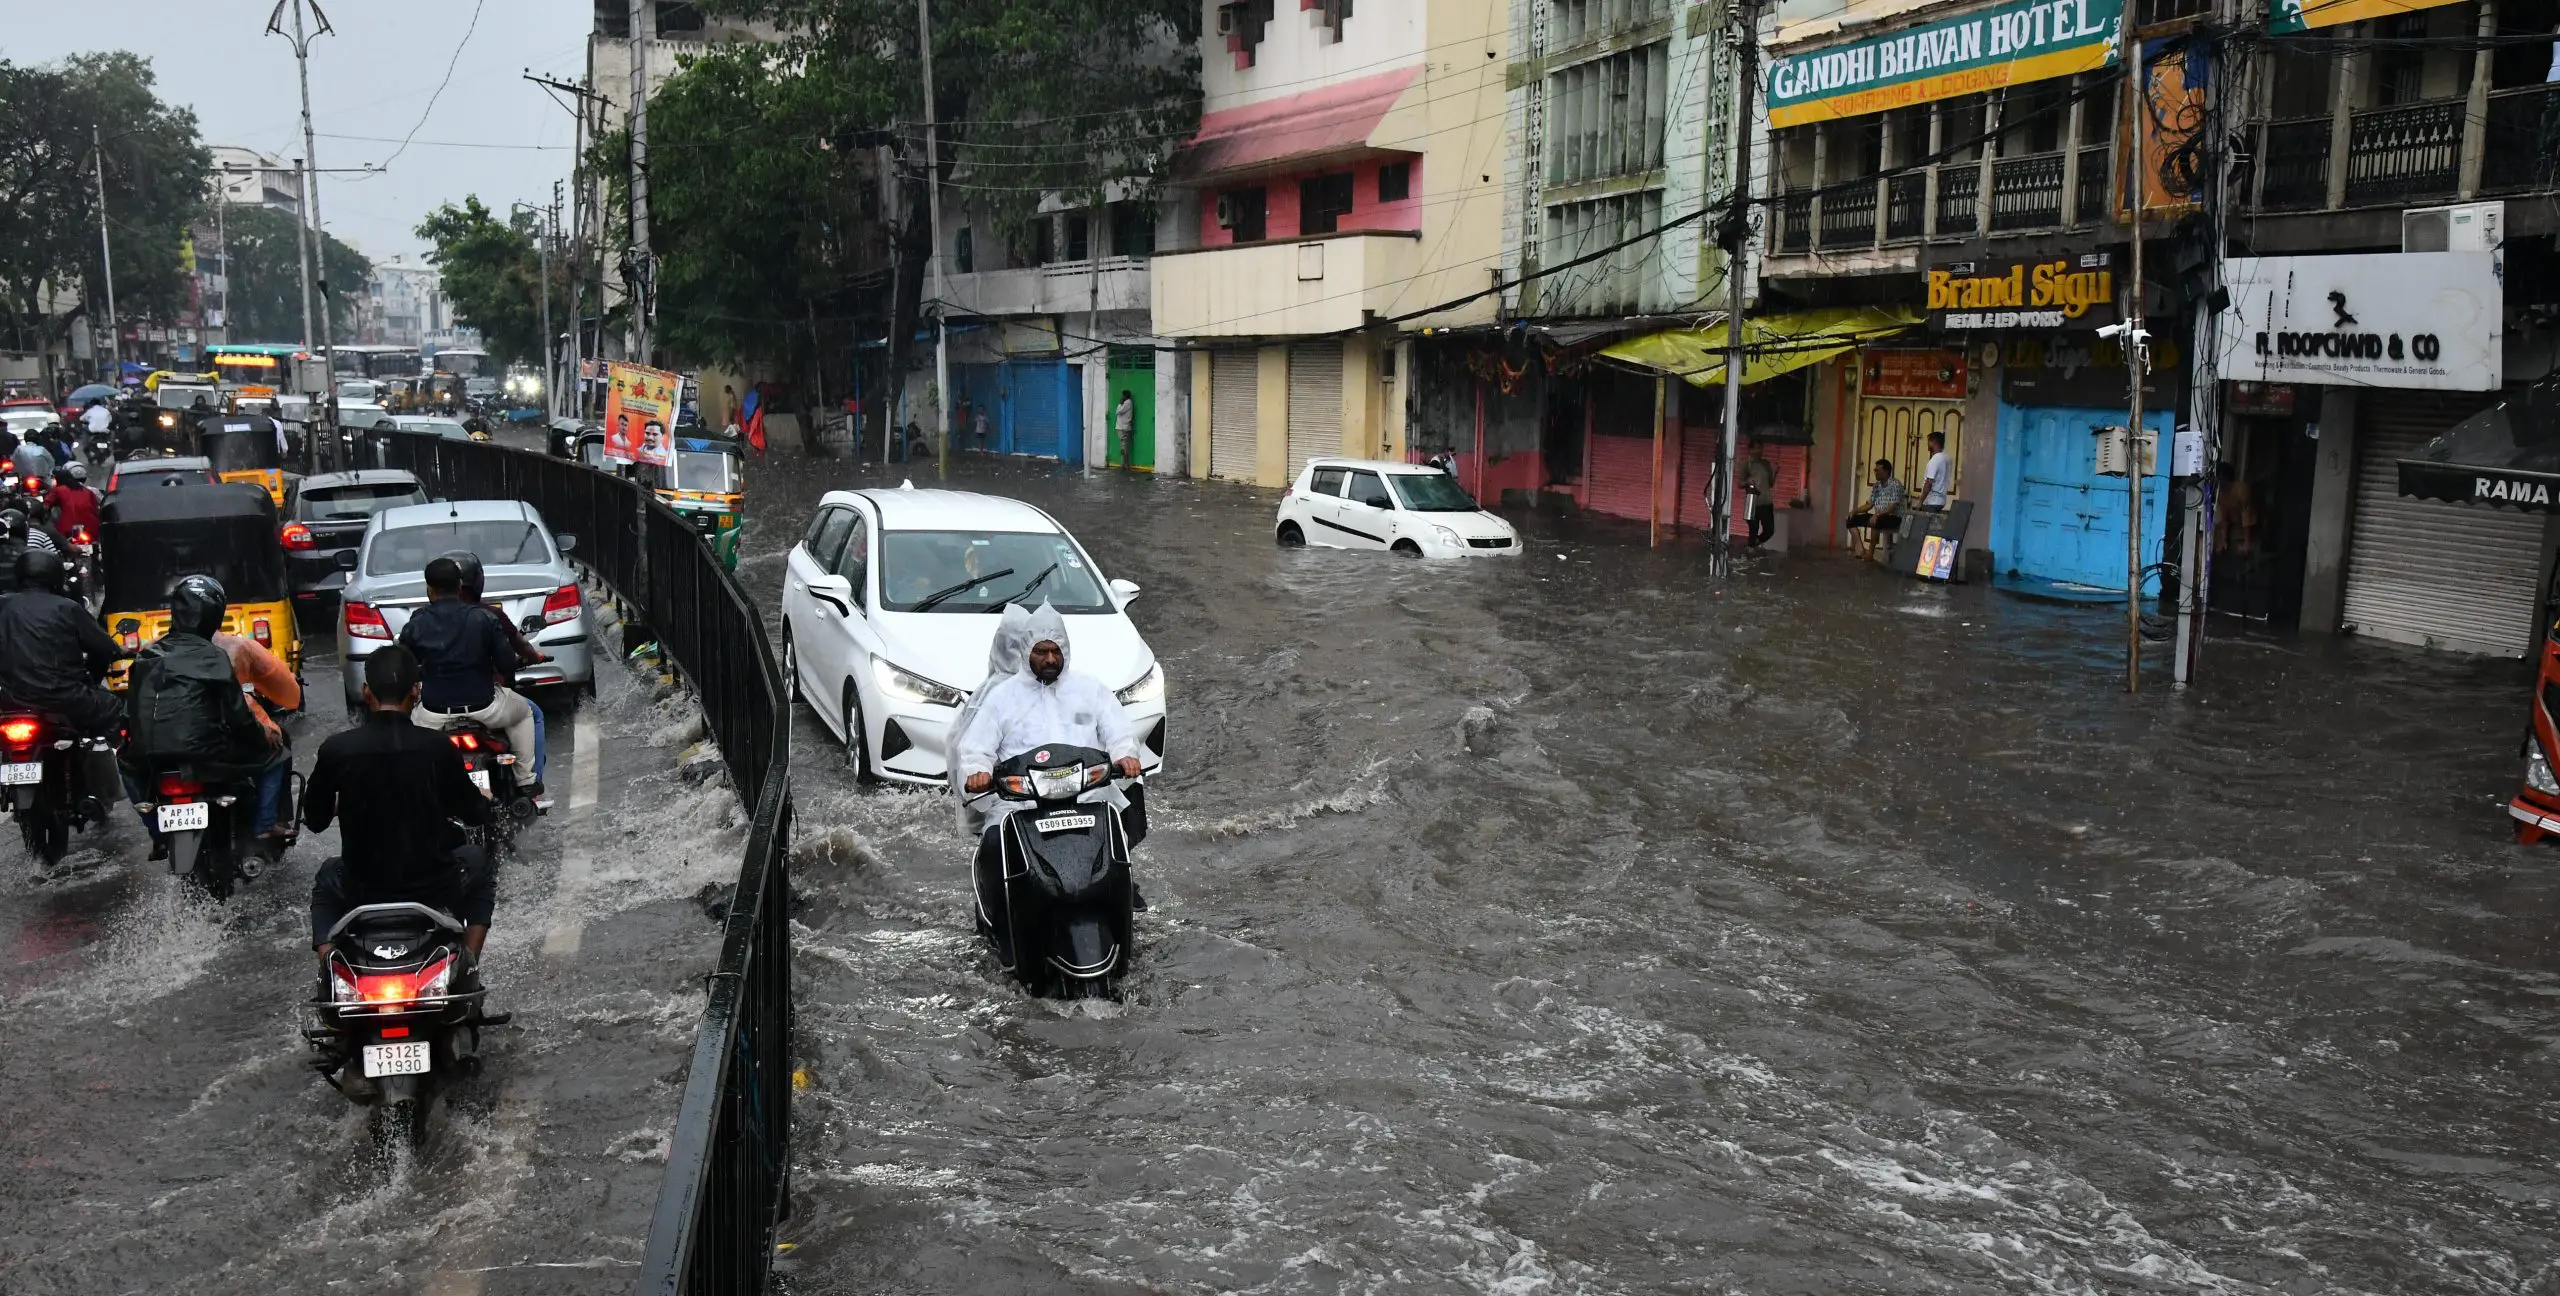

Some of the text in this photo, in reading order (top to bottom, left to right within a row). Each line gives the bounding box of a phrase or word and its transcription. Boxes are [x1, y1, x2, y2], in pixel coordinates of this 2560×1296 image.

[1774, 0, 2106, 99] GANDHI BHAVAN HOTEL
[1927, 265, 2024, 309] Brand
[2277, 332, 2383, 360] ROOPCHAND
[2388, 333, 2405, 360] &
[2412, 333, 2440, 361] CO
[2475, 477, 2549, 505] RAMA
[7, 763, 37, 773] TG 07
[7, 772, 37, 781] G8540
[170, 807, 195, 817] AP 11
[163, 816, 203, 829] AP 6446
[376, 1044, 421, 1060] TS12E
[376, 1059, 422, 1075] Y1930
